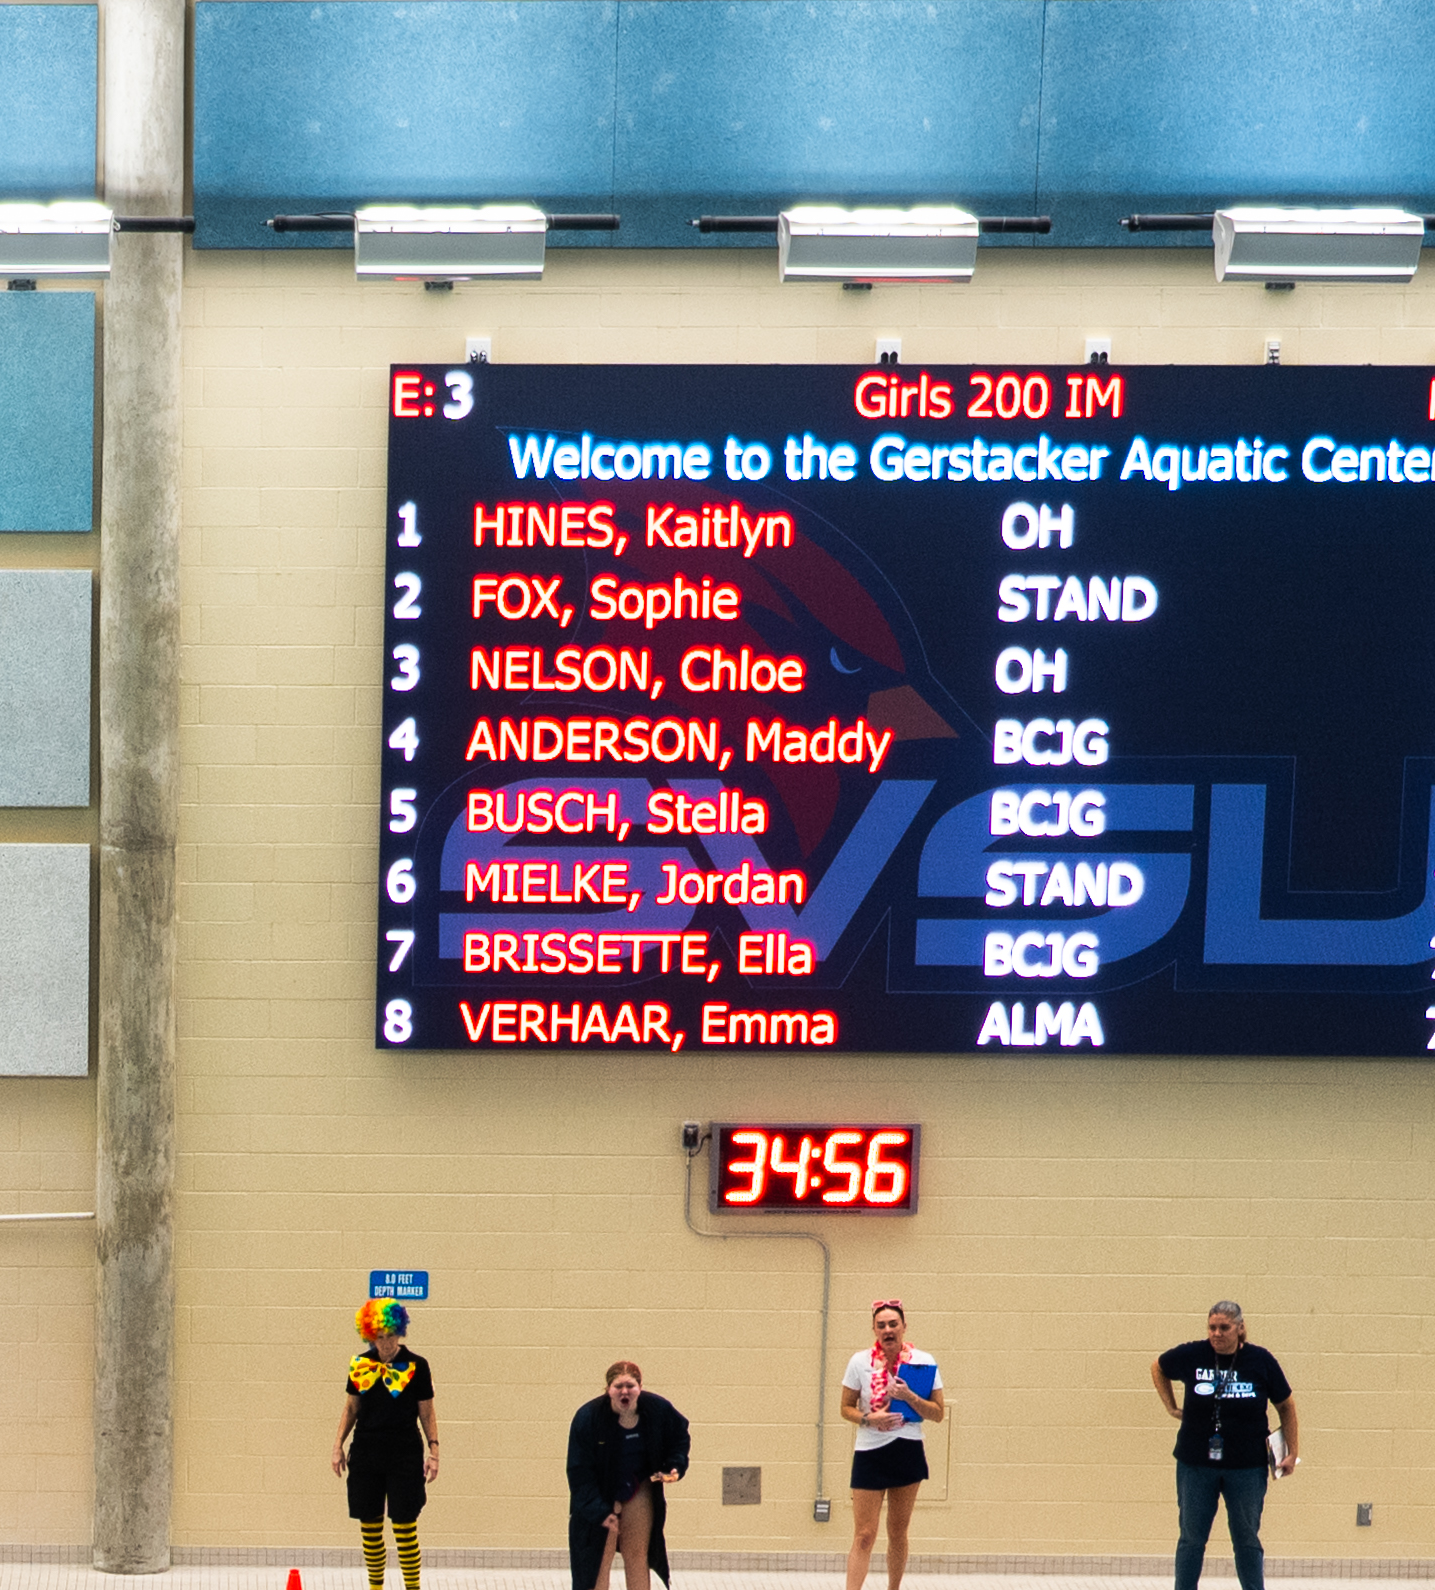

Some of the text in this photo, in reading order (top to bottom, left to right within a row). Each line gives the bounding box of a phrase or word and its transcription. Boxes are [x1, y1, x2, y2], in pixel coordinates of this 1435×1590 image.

[393, 375, 436, 417] E:
[442, 371, 475, 420] 3
[854, 372, 954, 420] Girls
[967, 375, 1051, 420] 200
[1064, 376, 1125, 420] IM
[509, 432, 710, 480] Welcome
[724, 439, 771, 481] to
[784, 433, 858, 481] the
[870, 433, 1110, 482] Gerstacker
[1120, 434, 1289, 490] Aquatic
[398, 501, 423, 548] 1
[473, 504, 629, 557] HINES,
[645, 503, 794, 558] Kaitlyn
[1000, 501, 1075, 550] OH
[393, 572, 422, 619] 2
[471, 575, 575, 628] FOX,
[589, 574, 741, 629] Sophie
[997, 574, 1159, 623] STAND
[390, 644, 421, 691] 3
[469, 648, 665, 699] NELSON,
[680, 646, 806, 692] Chloe
[994, 646, 1069, 694] OH
[387, 717, 420, 762] 4
[465, 719, 734, 770] ANDERSON,
[745, 719, 892, 772] Maddy
[992, 718, 1110, 767] BCJG
[388, 788, 418, 834] 5
[466, 792, 631, 842] BUSCH,
[646, 791, 768, 835] Stella
[989, 789, 1107, 838] BCJG
[385, 858, 417, 904] 6
[464, 864, 641, 911] MIELKE,
[655, 863, 806, 905] Jordan
[984, 860, 1145, 908] STAND
[385, 930, 415, 973] 7
[462, 933, 722, 982] BRISSETTE,
[737, 934, 815, 976] Ella
[983, 931, 1100, 978] BCJG
[383, 998, 413, 1044] 8
[460, 1003, 686, 1052] VERHAAR,
[701, 1004, 837, 1046] Emma
[976, 1001, 1106, 1047] ALMA
[726, 1130, 908, 1204] 34:56
[374, 1285, 423, 1297] DEPTH MARKER
[398, 1273, 413, 1284] FEET
